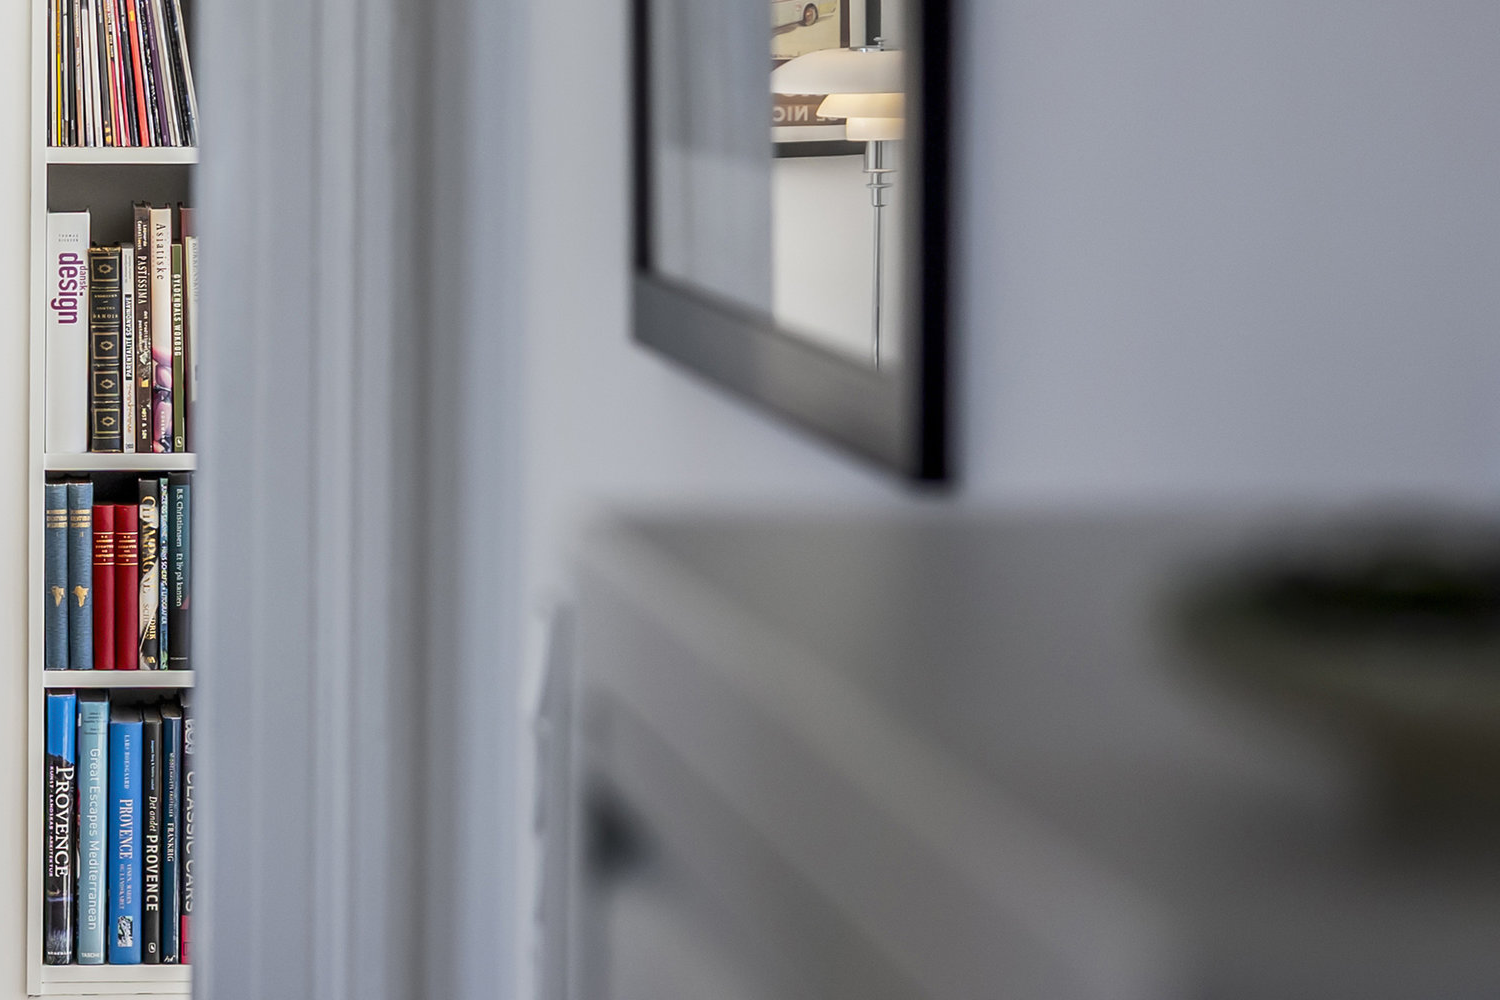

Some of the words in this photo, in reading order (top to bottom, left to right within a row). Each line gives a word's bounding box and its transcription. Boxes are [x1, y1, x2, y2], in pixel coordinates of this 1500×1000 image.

[156, 223, 167, 280] Asiatiske
[51, 252, 83, 324] design
[79, 265, 88, 291] dansk
[138, 256, 147, 304] PASTISSIMA
[173, 274, 181, 322] GYLDENDALS
[175, 572, 183, 580] på
[176, 553, 182, 561] Et
[89, 748, 100, 781] Great
[54, 765, 74, 877] PROVENCE
[86, 786, 100, 836] Escapes
[149, 796, 157, 809] Det
[149, 811, 157, 832] andet
[119, 799, 133, 859] PROVENCE
[166, 823, 174, 862] FRANKRIG
[87, 840, 100, 930] Mediterranean
[145, 835, 158, 911] PROVENCE
